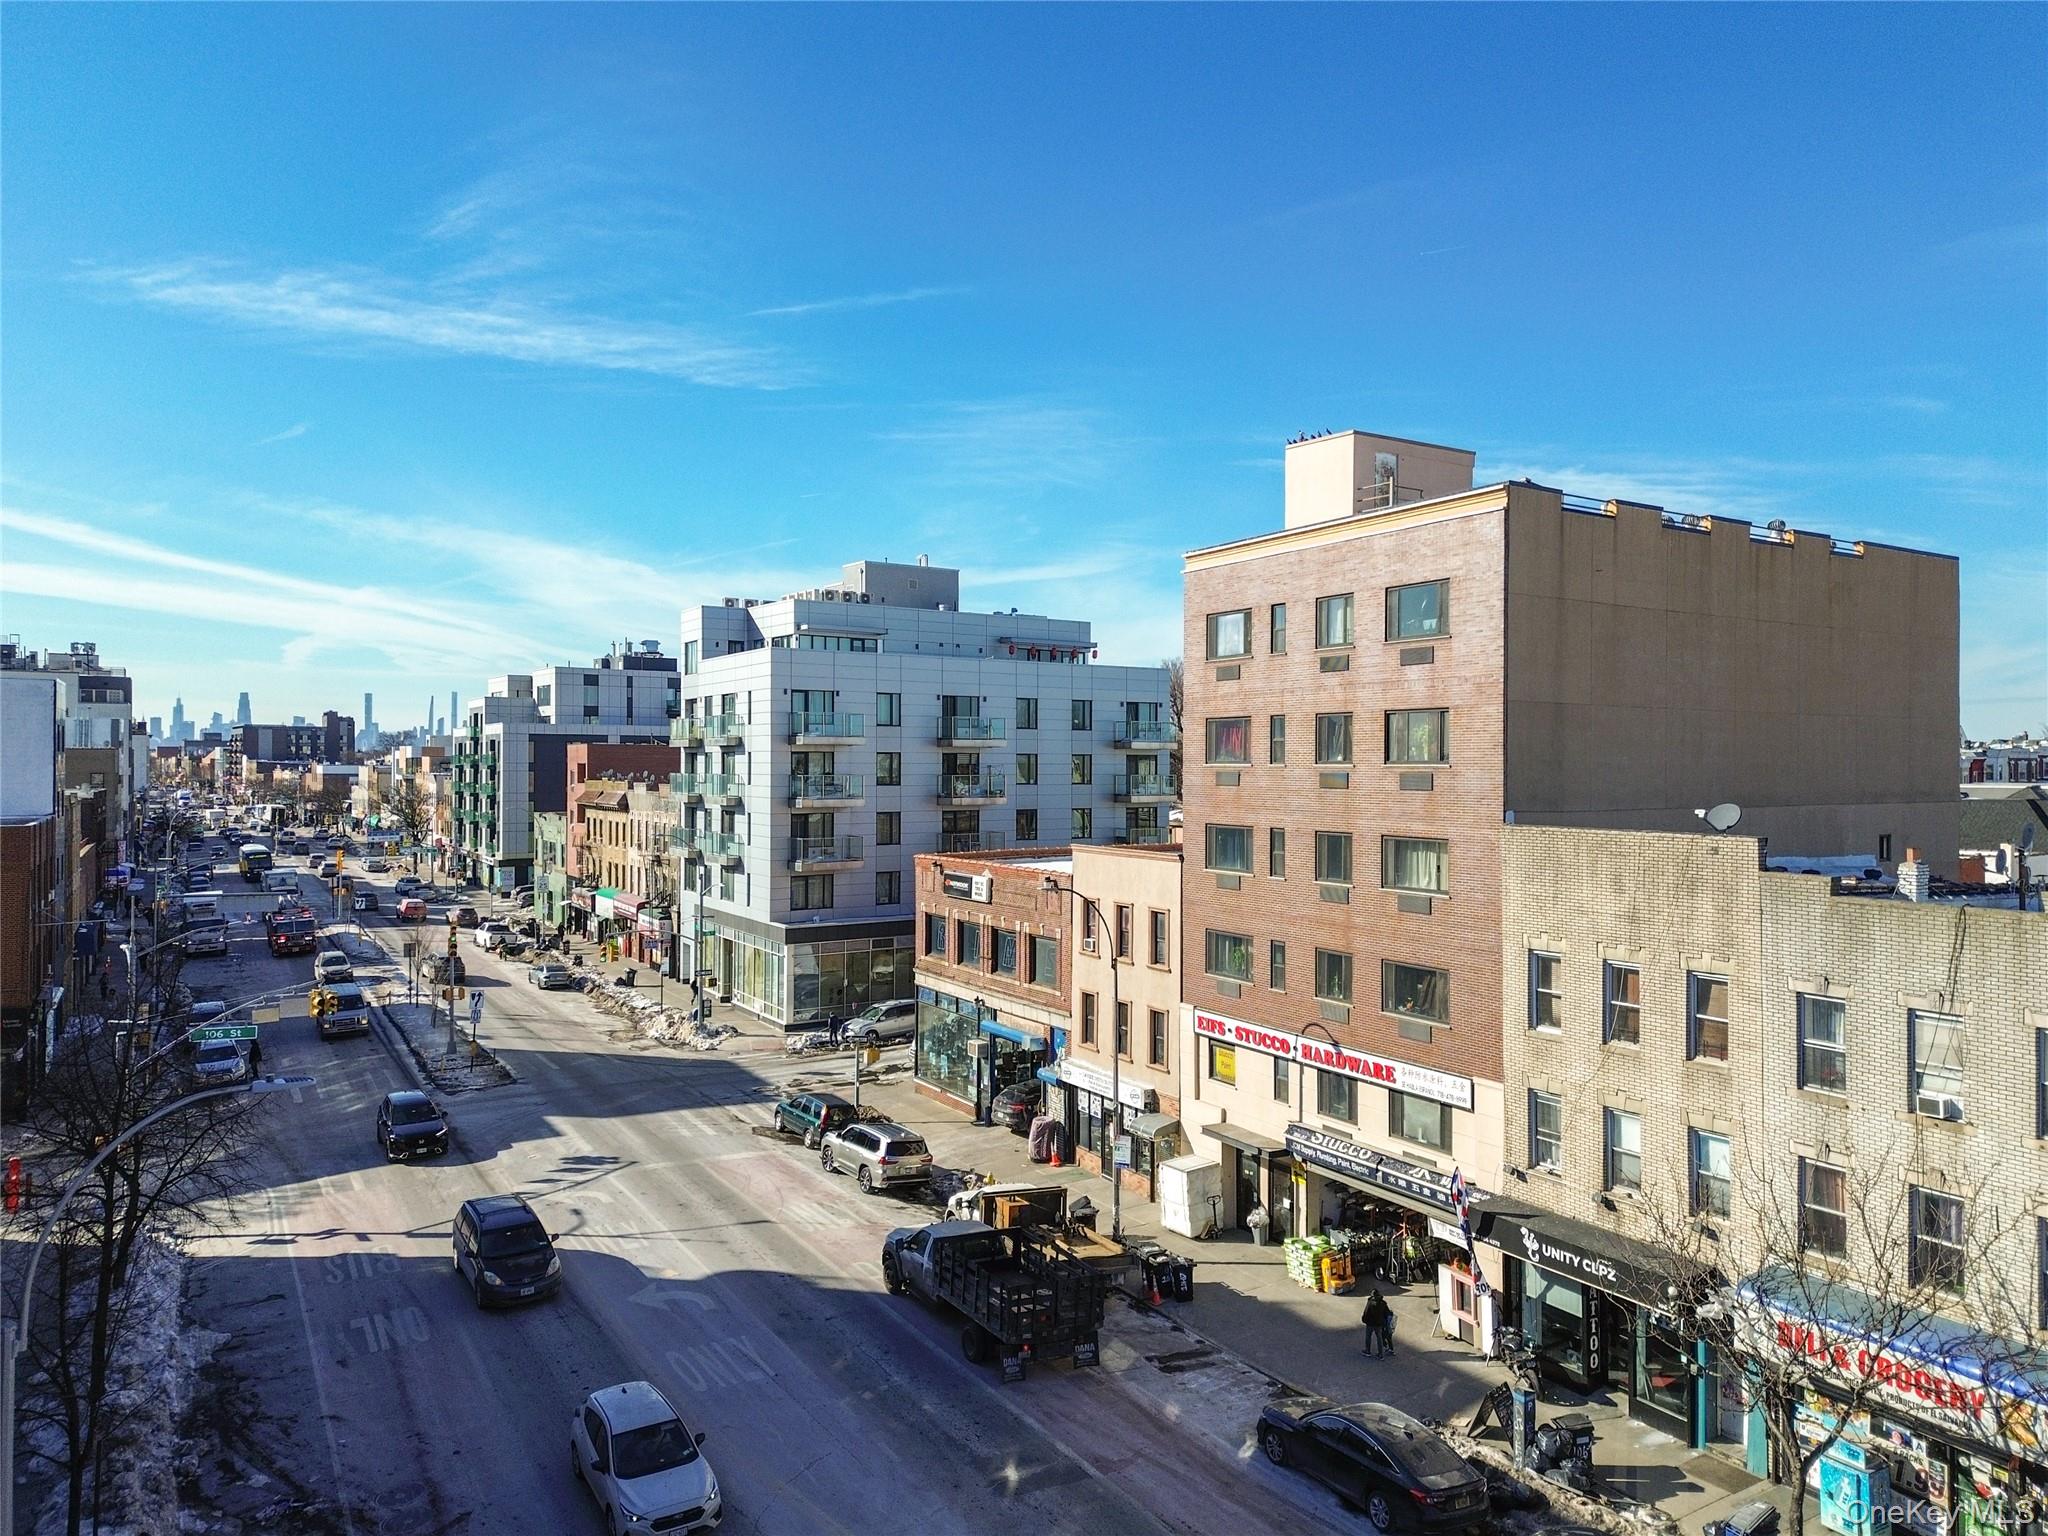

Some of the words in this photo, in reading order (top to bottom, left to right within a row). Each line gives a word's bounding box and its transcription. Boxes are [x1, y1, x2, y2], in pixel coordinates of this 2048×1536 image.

[205, 1030, 224, 1039] 106
[230, 1029, 242, 1037] St
[1197, 1015, 1226, 1037] EIFS
[1234, 1025, 1291, 1055] STUCCO
[1301, 1042, 1397, 1084] HARDWARE
[1541, 1243, 1581, 1268] UNITY
[666, 1336, 777, 1391] ONLY
[1074, 1343, 1095, 1353] DANA
[1858, 1349, 1984, 1420] GROCERY
